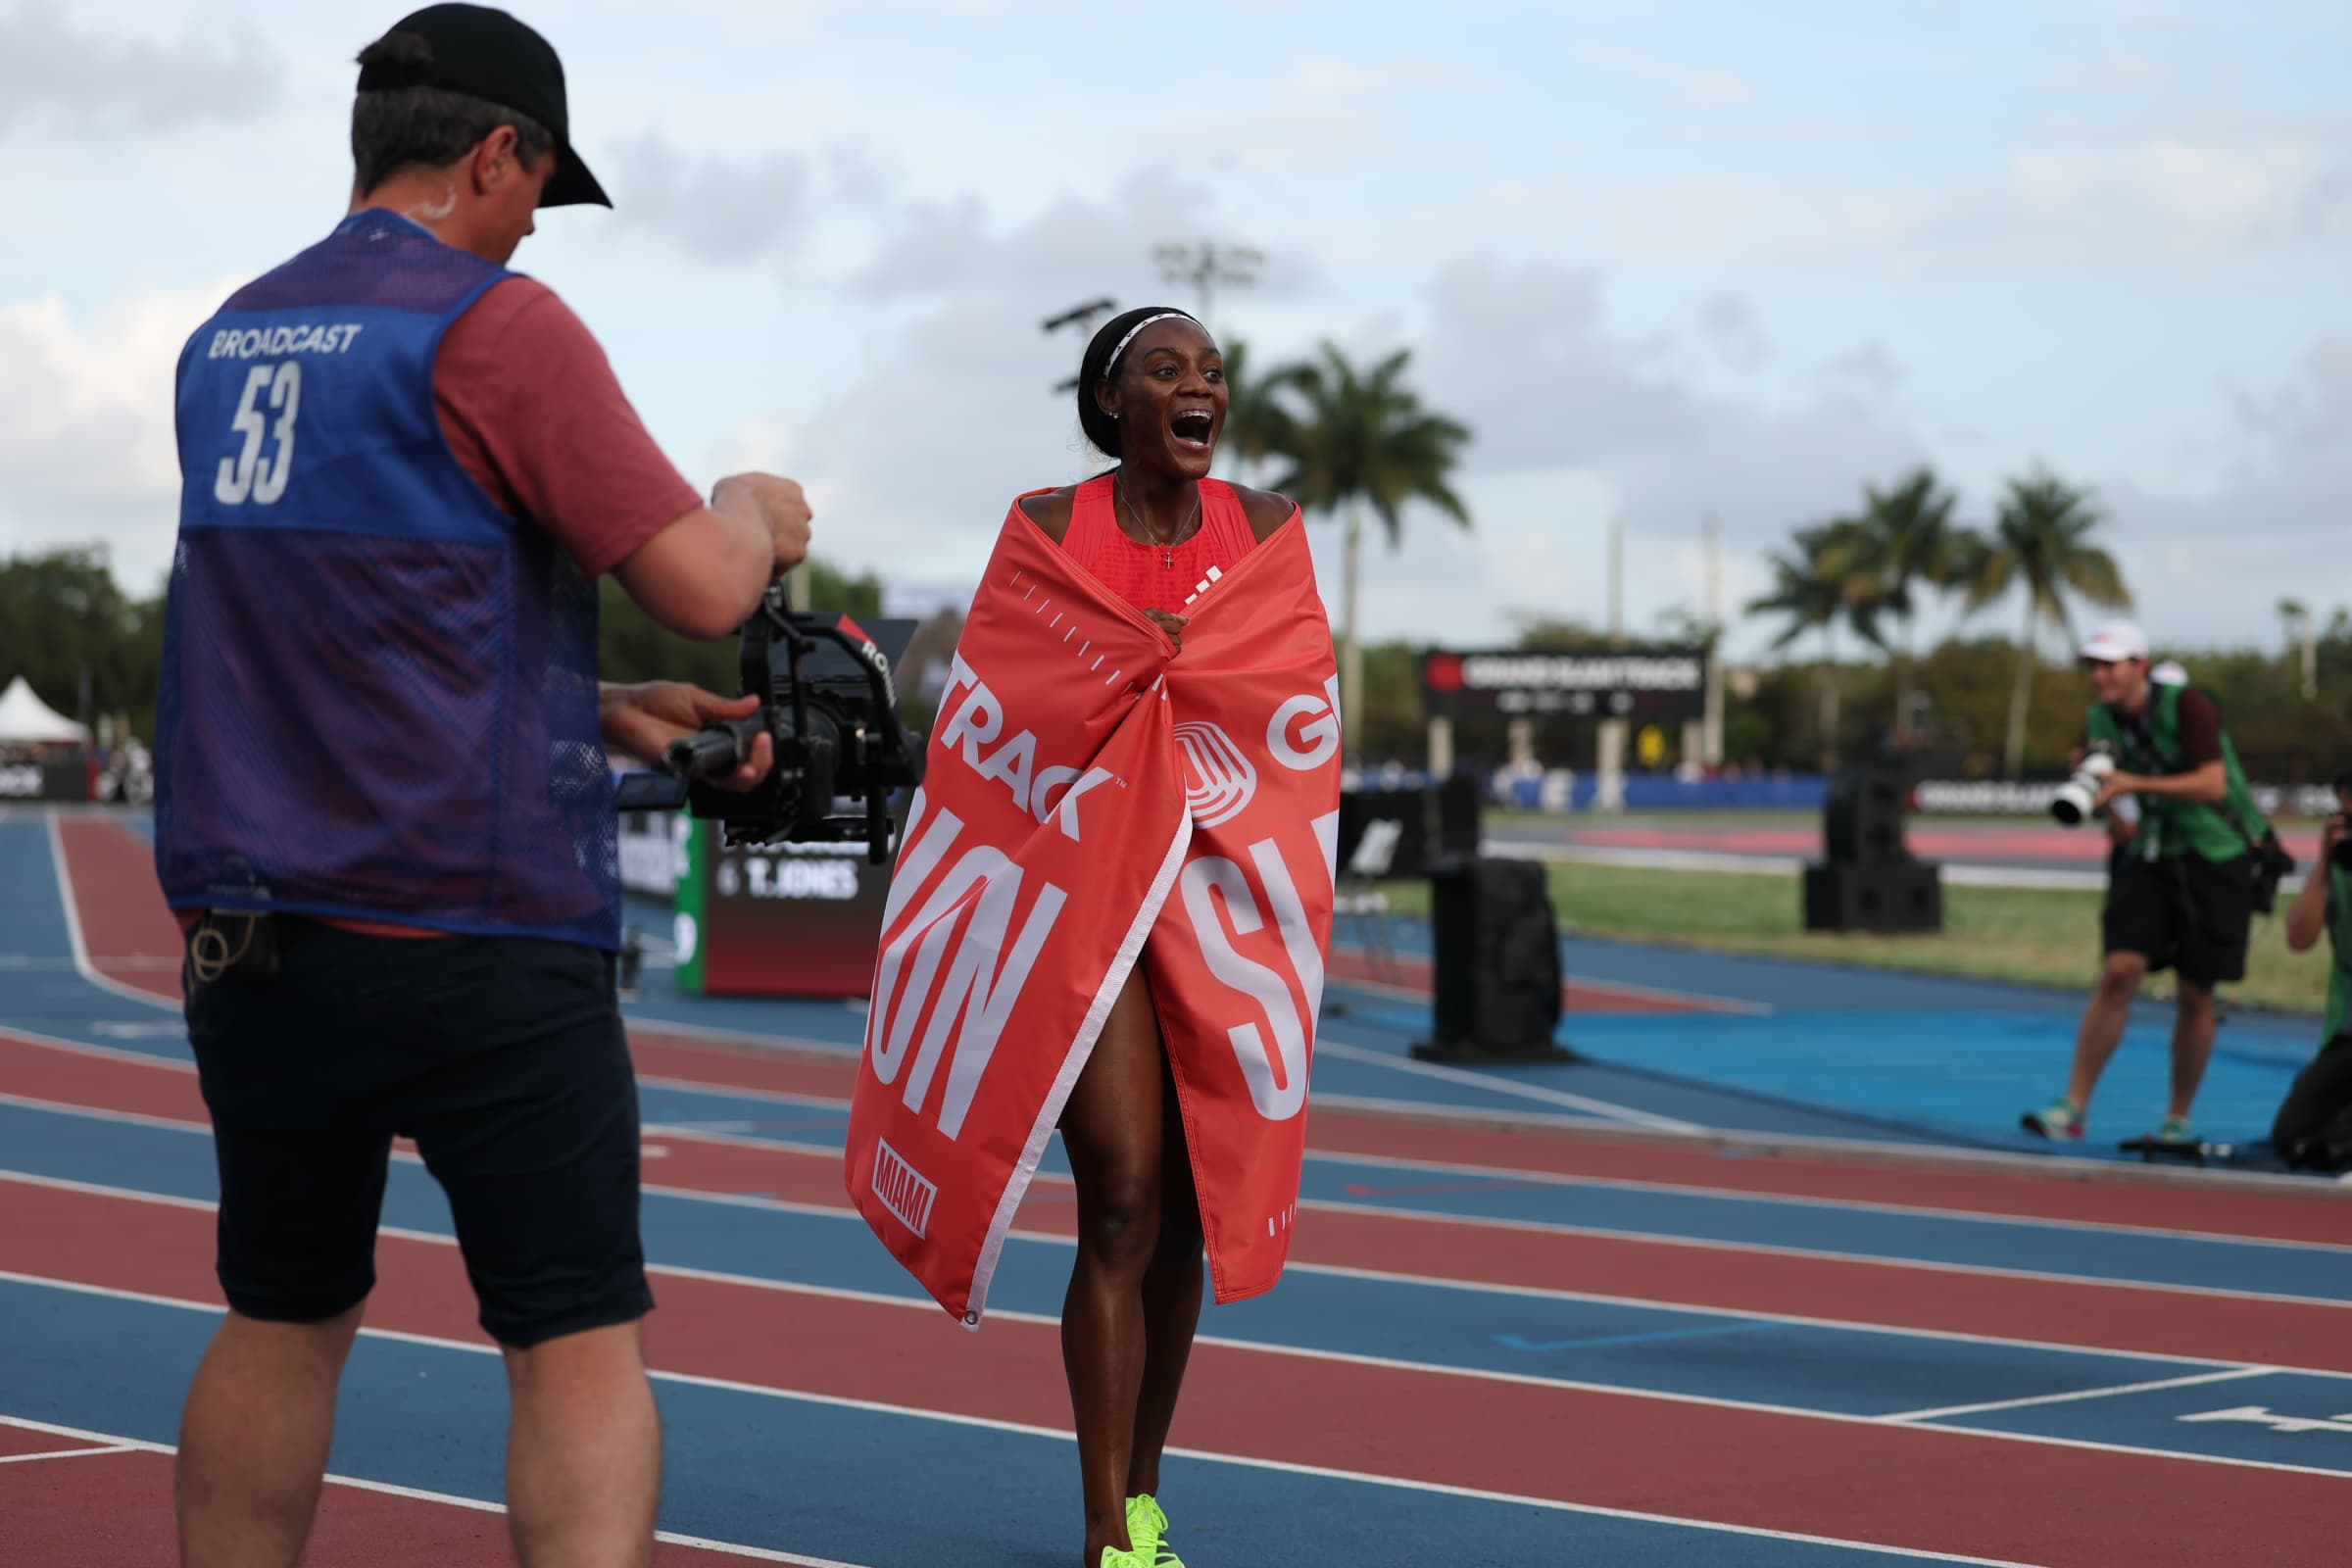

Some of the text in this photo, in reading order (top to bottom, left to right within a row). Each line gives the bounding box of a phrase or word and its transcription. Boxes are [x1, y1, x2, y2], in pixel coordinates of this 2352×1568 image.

[208, 323, 364, 360] BROADCAST
[214, 360, 302, 506] 53
[932, 648, 1114, 843] TRACK
[875, 1145, 932, 1233] MIAMI
